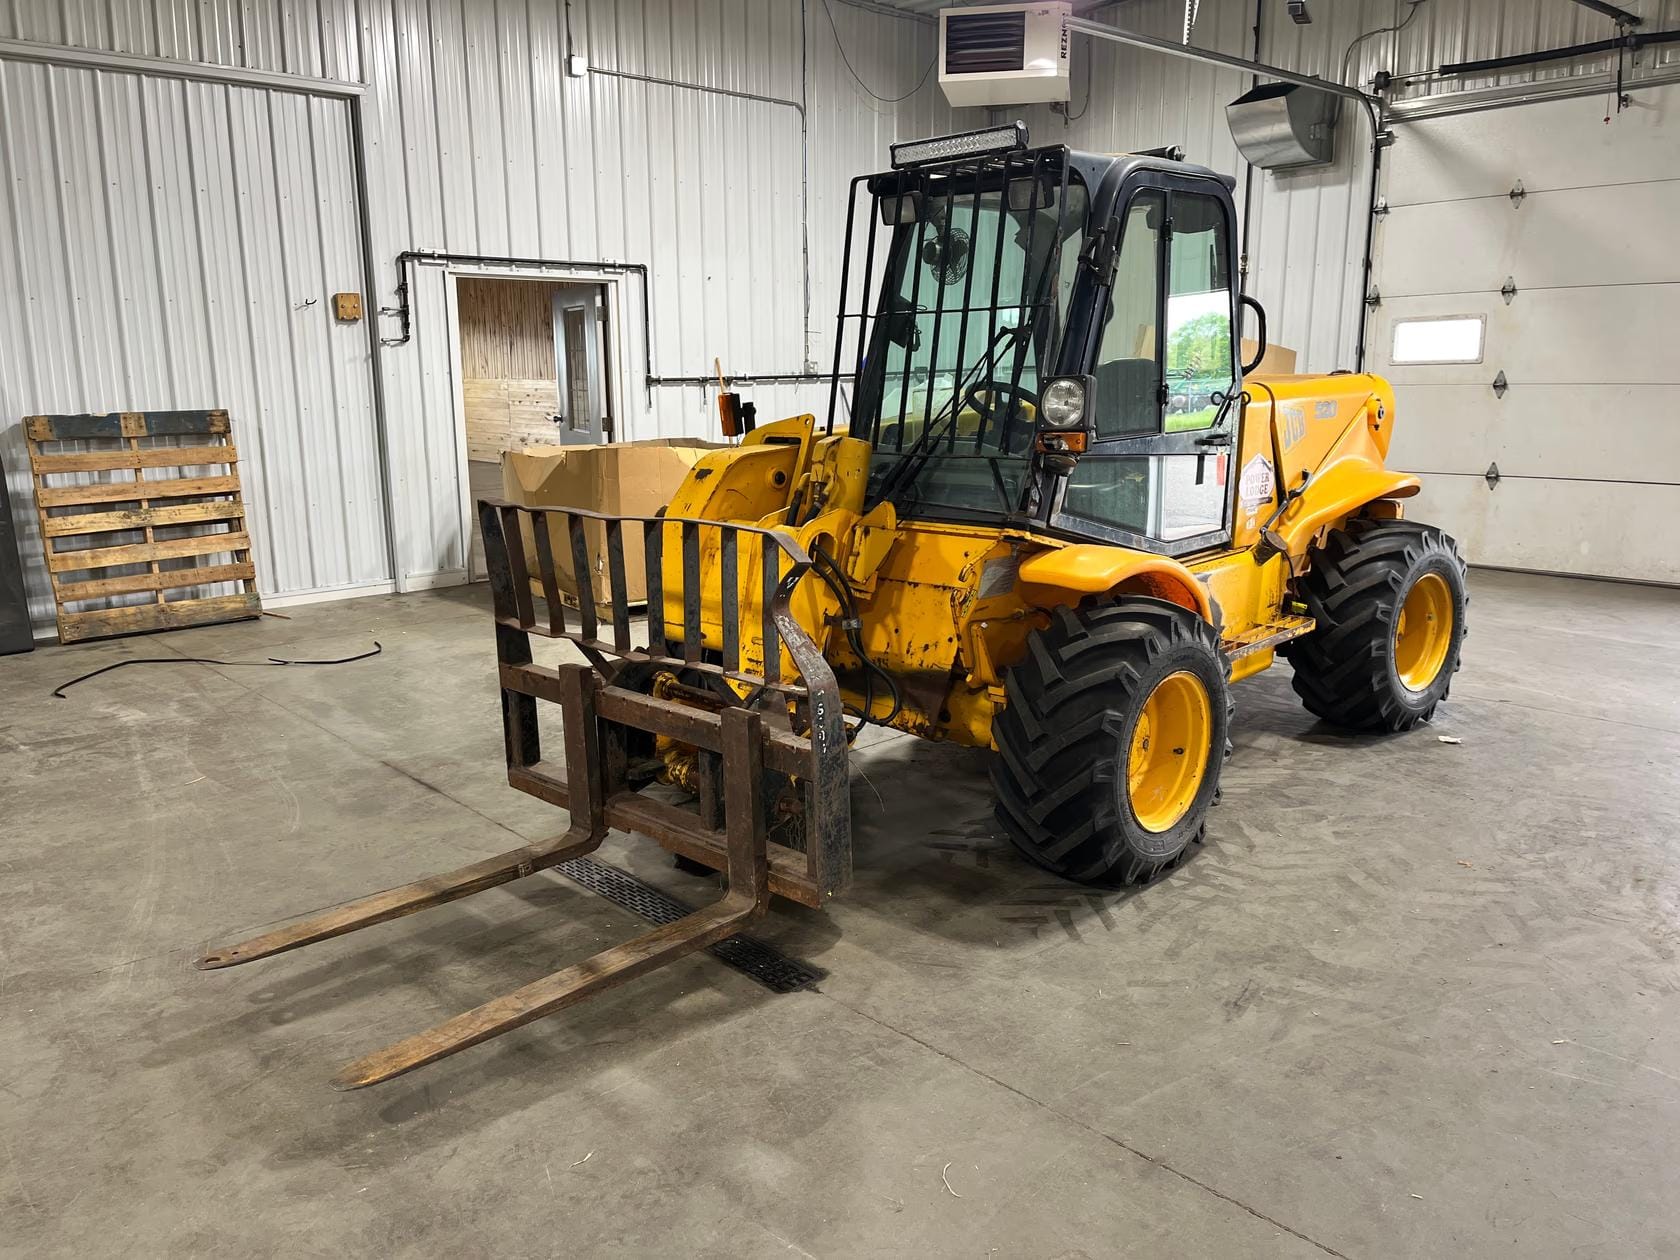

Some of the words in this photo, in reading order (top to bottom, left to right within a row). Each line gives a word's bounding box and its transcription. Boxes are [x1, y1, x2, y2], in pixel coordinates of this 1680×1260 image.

[1283, 407, 1305, 449] JCB
[1245, 473, 1270, 485] POWER
[1245, 484, 1269, 497] LODGE
